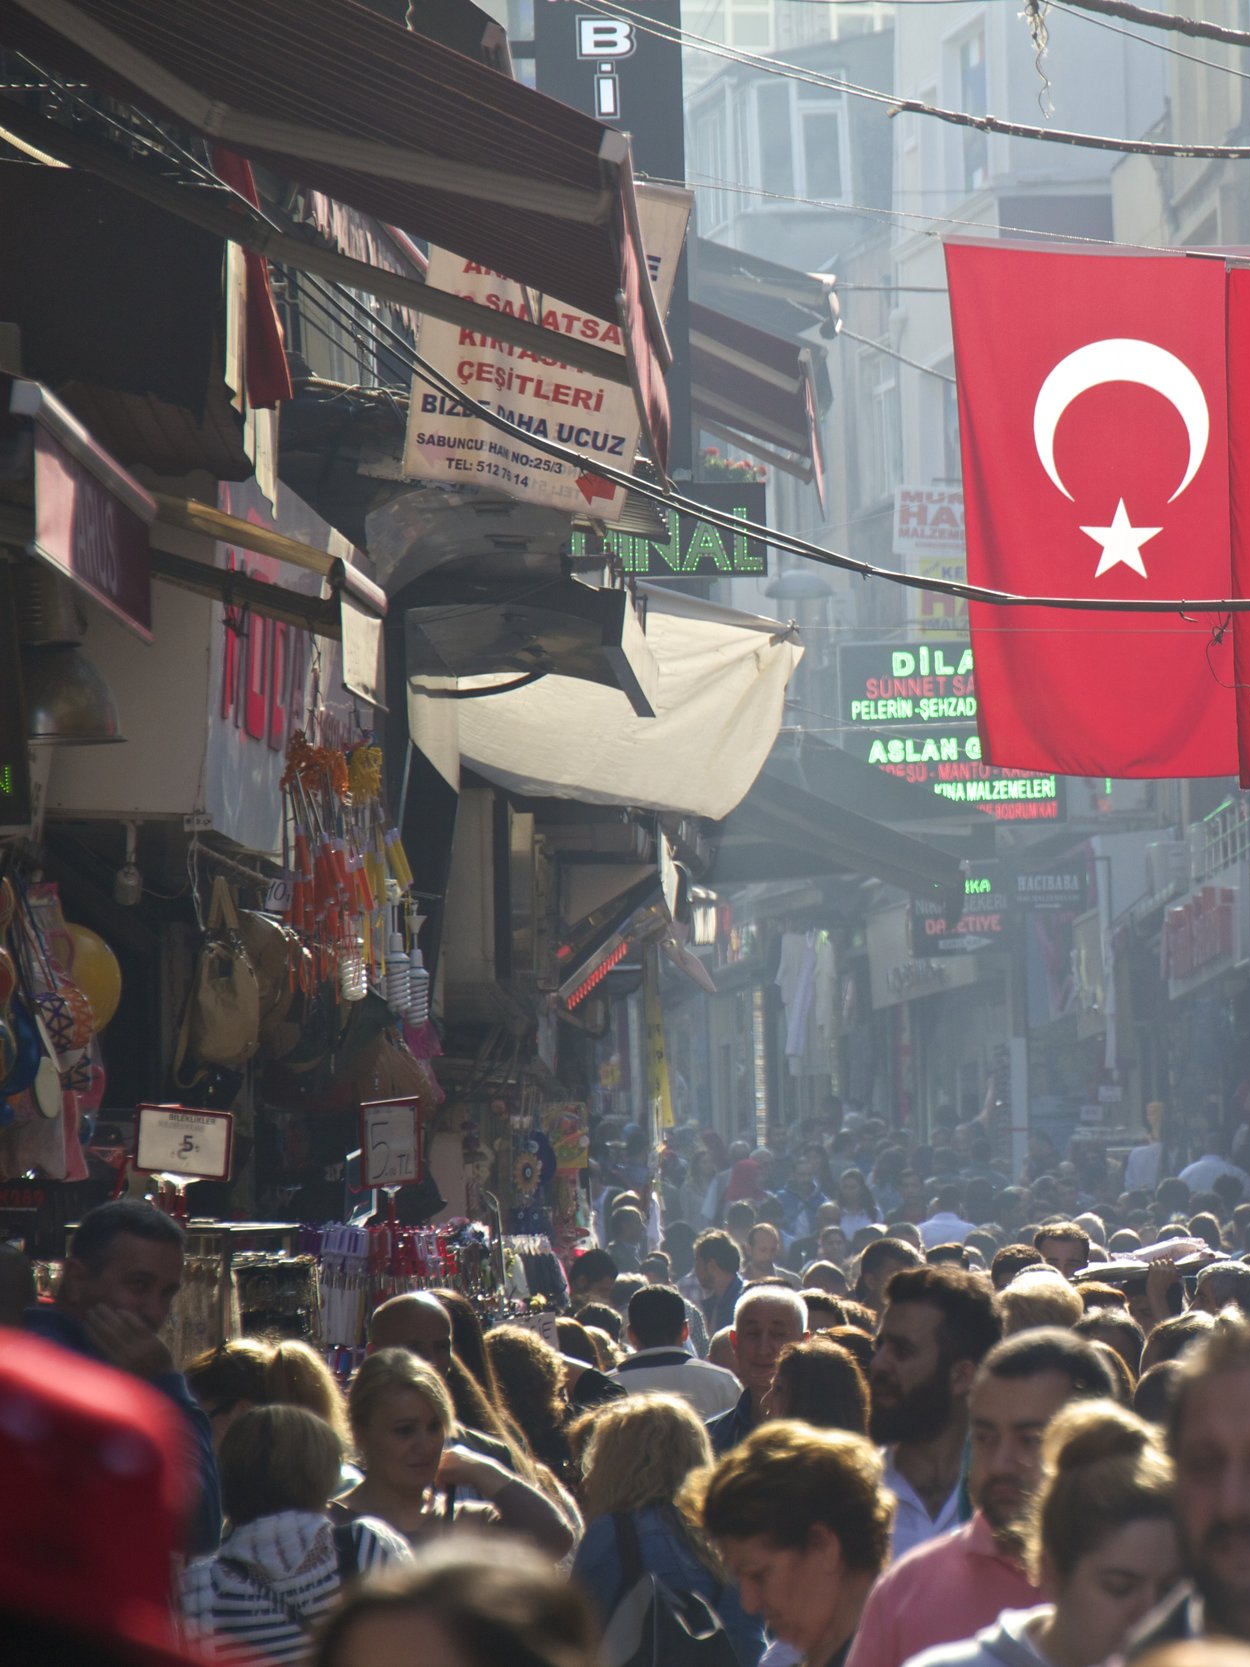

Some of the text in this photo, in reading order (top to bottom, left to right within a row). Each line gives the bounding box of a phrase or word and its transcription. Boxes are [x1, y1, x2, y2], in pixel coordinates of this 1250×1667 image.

[457, 360, 605, 413] ÇEŞİTLERİ
[416, 432, 484, 451] SABUNCU
[511, 451, 562, 474] NO:25/3
[557, 422, 626, 456] UCUZ
[446, 457, 473, 471] TEL:
[476, 460, 500, 476] 512
[868, 739, 958, 764] ASLAN
